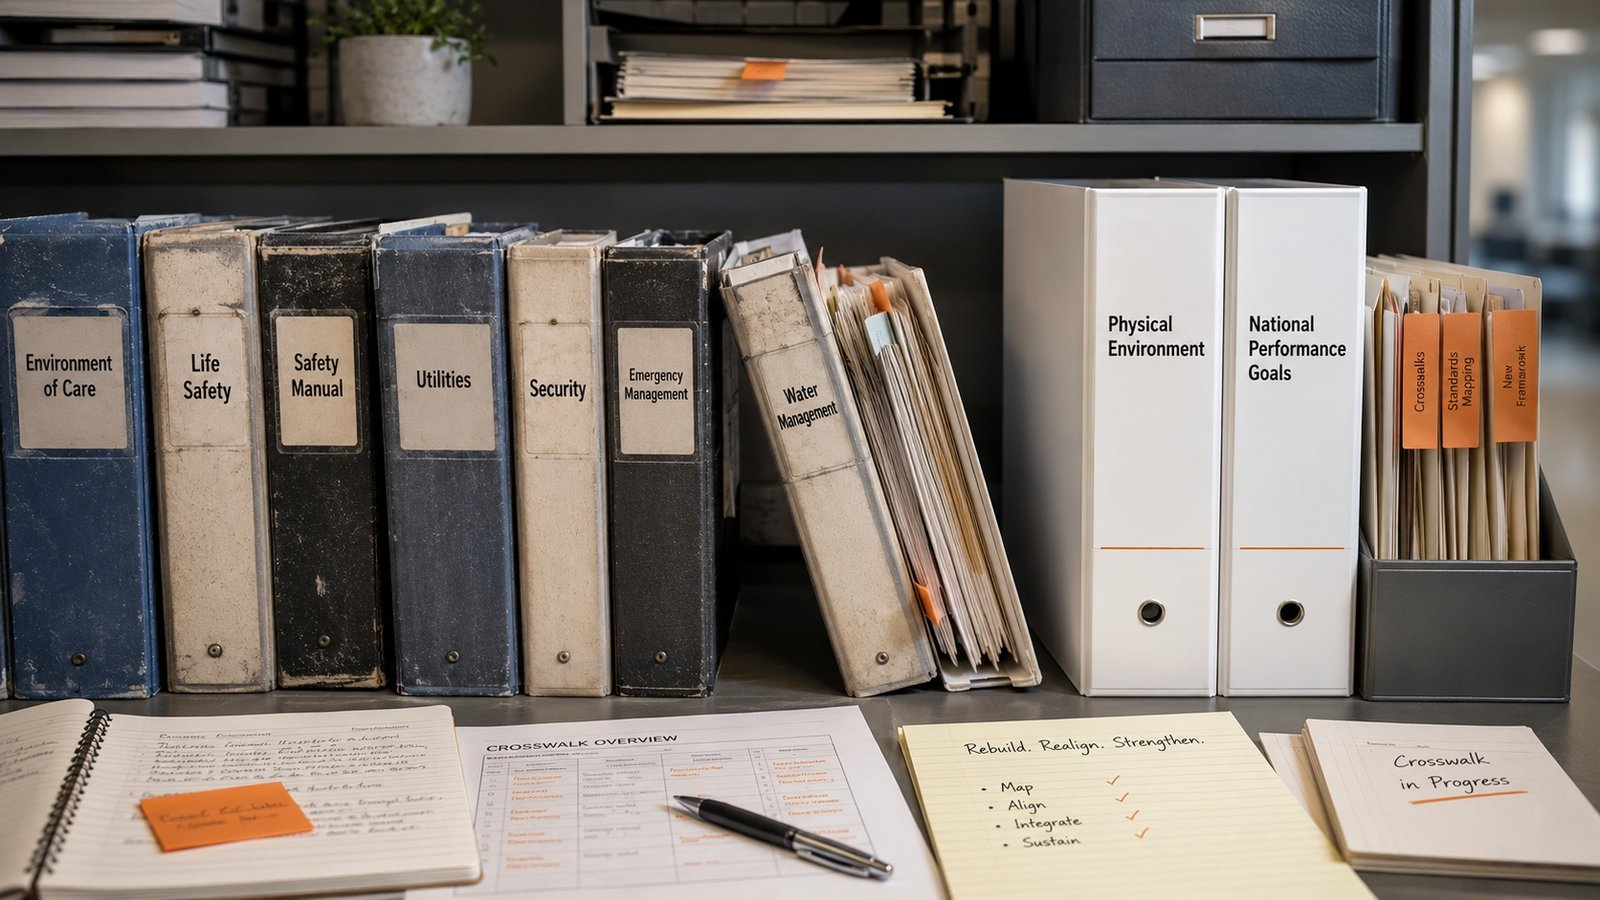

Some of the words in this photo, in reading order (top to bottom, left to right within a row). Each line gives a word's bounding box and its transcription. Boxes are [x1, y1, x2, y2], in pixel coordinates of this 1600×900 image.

[1108, 315, 1173, 337] Physical
[1249, 314, 1315, 333] National
[1108, 339, 1205, 357] Environment
[1249, 339, 1347, 357] Performance
[25, 353, 113, 372] Environment
[191, 353, 220, 373] Life
[294, 353, 339, 377] Safety
[1248, 363, 1292, 381] Goals
[416, 369, 472, 389] Utilities
[629, 367, 684, 386] Emergency
[1447, 352, 1459, 411] Standards
[1461, 357, 1475, 407] Mapping
[43, 378, 59, 397] of
[62, 379, 96, 397] Care
[183, 380, 232, 404] Safety
[291, 379, 343, 397] Manual
[529, 379, 587, 403] Security
[624, 387, 689, 404] Management
[782, 384, 818, 405] Water
[776, 400, 839, 430] Management
[486, 739, 589, 752] CROSSWALK
[594, 734, 679, 746] OVERVIEW
[964, 741, 1032, 755] Rebuild.
[1039, 739, 1104, 755] Realign.
[1112, 734, 1205, 751] Strengthen.
[1394, 752, 1491, 768] Crosswalk
[1001, 782, 1034, 796] Map
[1400, 779, 1420, 790] in
[1428, 775, 1510, 794] Progress
[1008, 799, 1047, 815] Align
[1014, 816, 1083, 833] Integrate
[1022, 837, 1081, 848] Sustain
